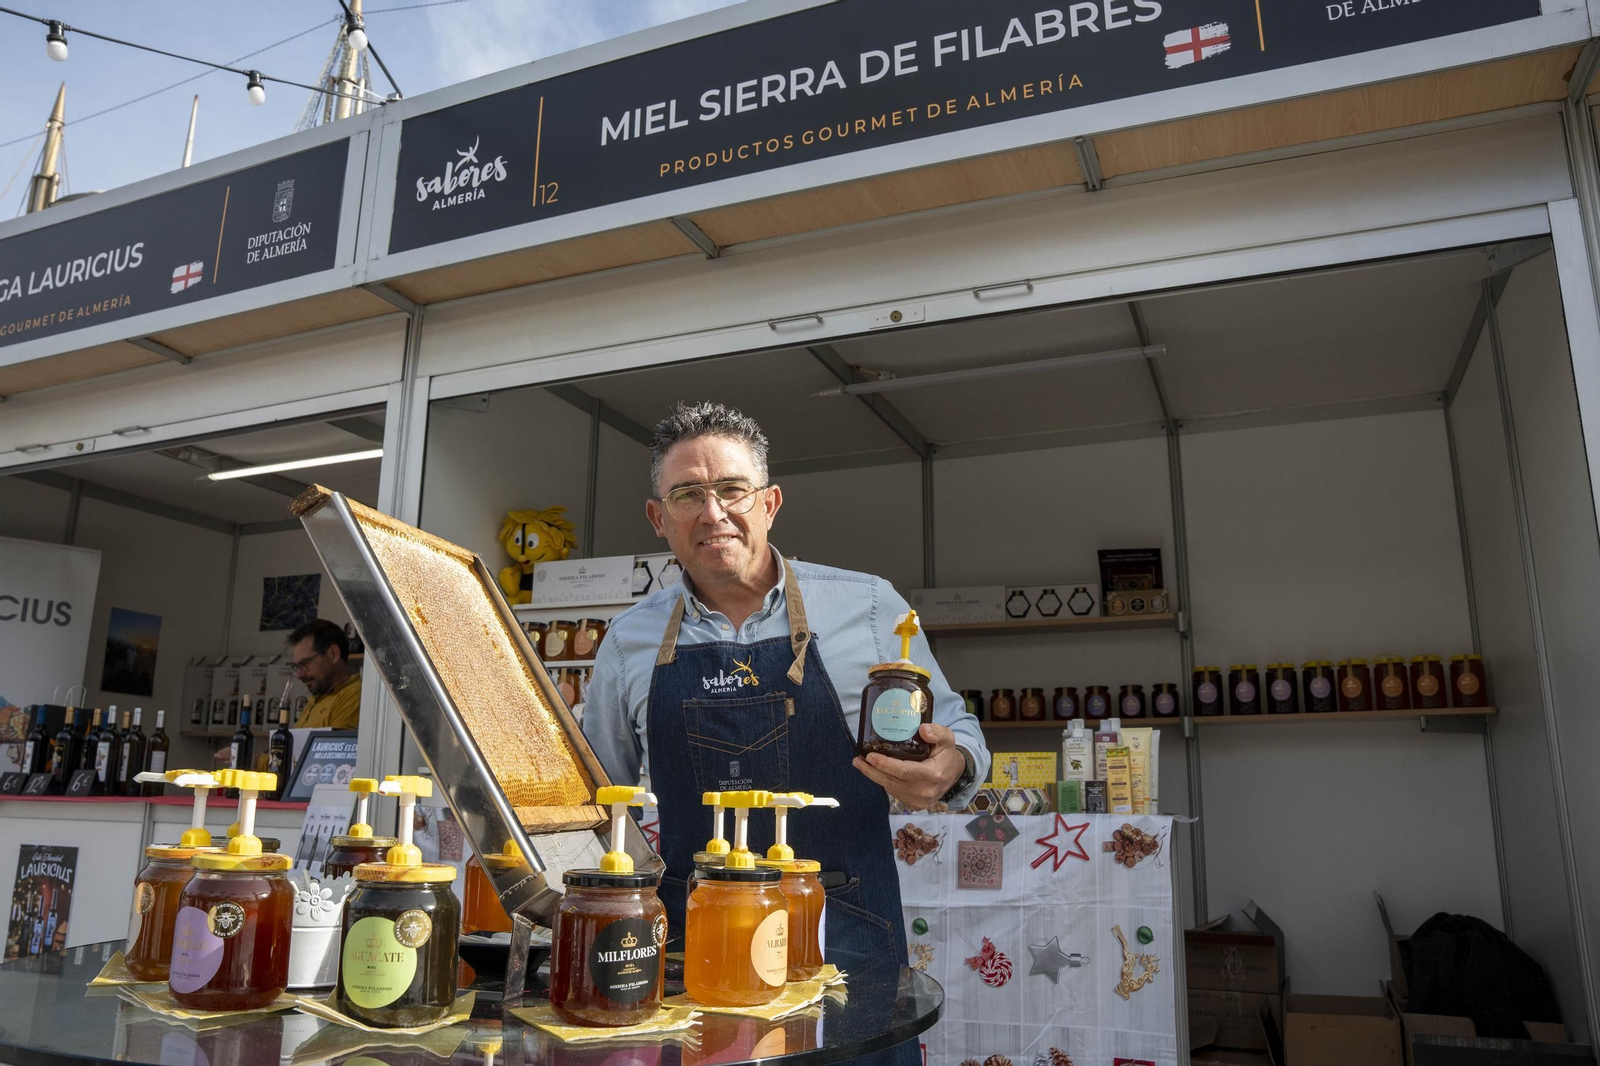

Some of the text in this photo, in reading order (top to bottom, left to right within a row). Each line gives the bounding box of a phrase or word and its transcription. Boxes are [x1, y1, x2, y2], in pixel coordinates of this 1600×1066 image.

[1326, 0, 1421, 20] DE ALM
[601, 0, 1163, 146] MIEL SIERRA DE FILABRES
[659, 73, 1084, 177] PRODUCTOS GOURMET DE ALMERÍA
[416, 155, 508, 202] sabores
[432, 188, 486, 211] ALMERÍA
[539, 182, 559, 205] 12
[247, 222, 311, 250] DIPUTACIÓN
[246, 238, 307, 264] DE ALMERÍA
[28, 242, 145, 295] LAURICIUS
[0, 294, 131, 336] GOURMET DE ALMERÍA
[0, 595, 72, 627] CIUS
[702, 668, 760, 690] sabores
[711, 686, 738, 694] ALMERÍA
[876, 707, 916, 717] EUCAIPTO
[312, 742, 345, 751] LAURICIUS
[718, 778, 753, 786] DIPUTACIÓN
[21, 862, 73, 883] LAURICIUS
[216, 903, 242, 914] PRODUCTO
[351, 951, 404, 963] AGUACATE
[597, 945, 657, 963] MILFLORES
